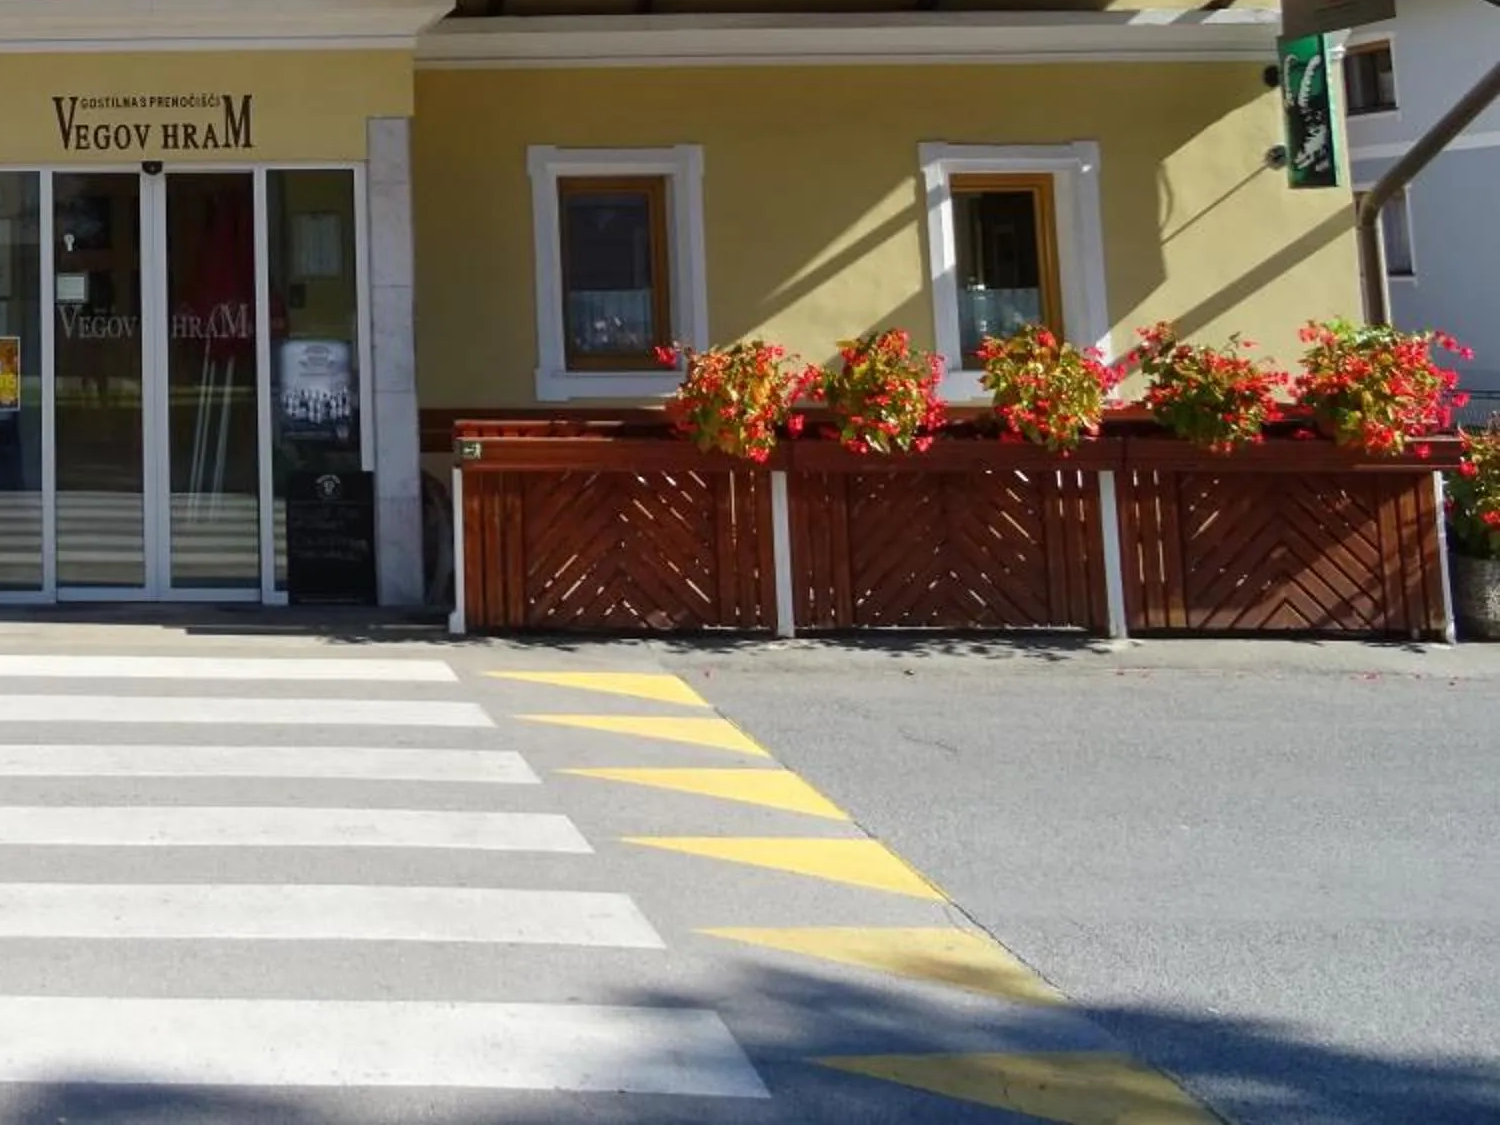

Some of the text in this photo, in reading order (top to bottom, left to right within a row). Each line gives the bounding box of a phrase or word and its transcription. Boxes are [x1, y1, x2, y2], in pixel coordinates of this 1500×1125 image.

[80, 95, 137, 110] GOSTILNA
[52, 94, 255, 150] VEGOV HRAM
[57, 303, 250, 340] VEGOV HRAM
